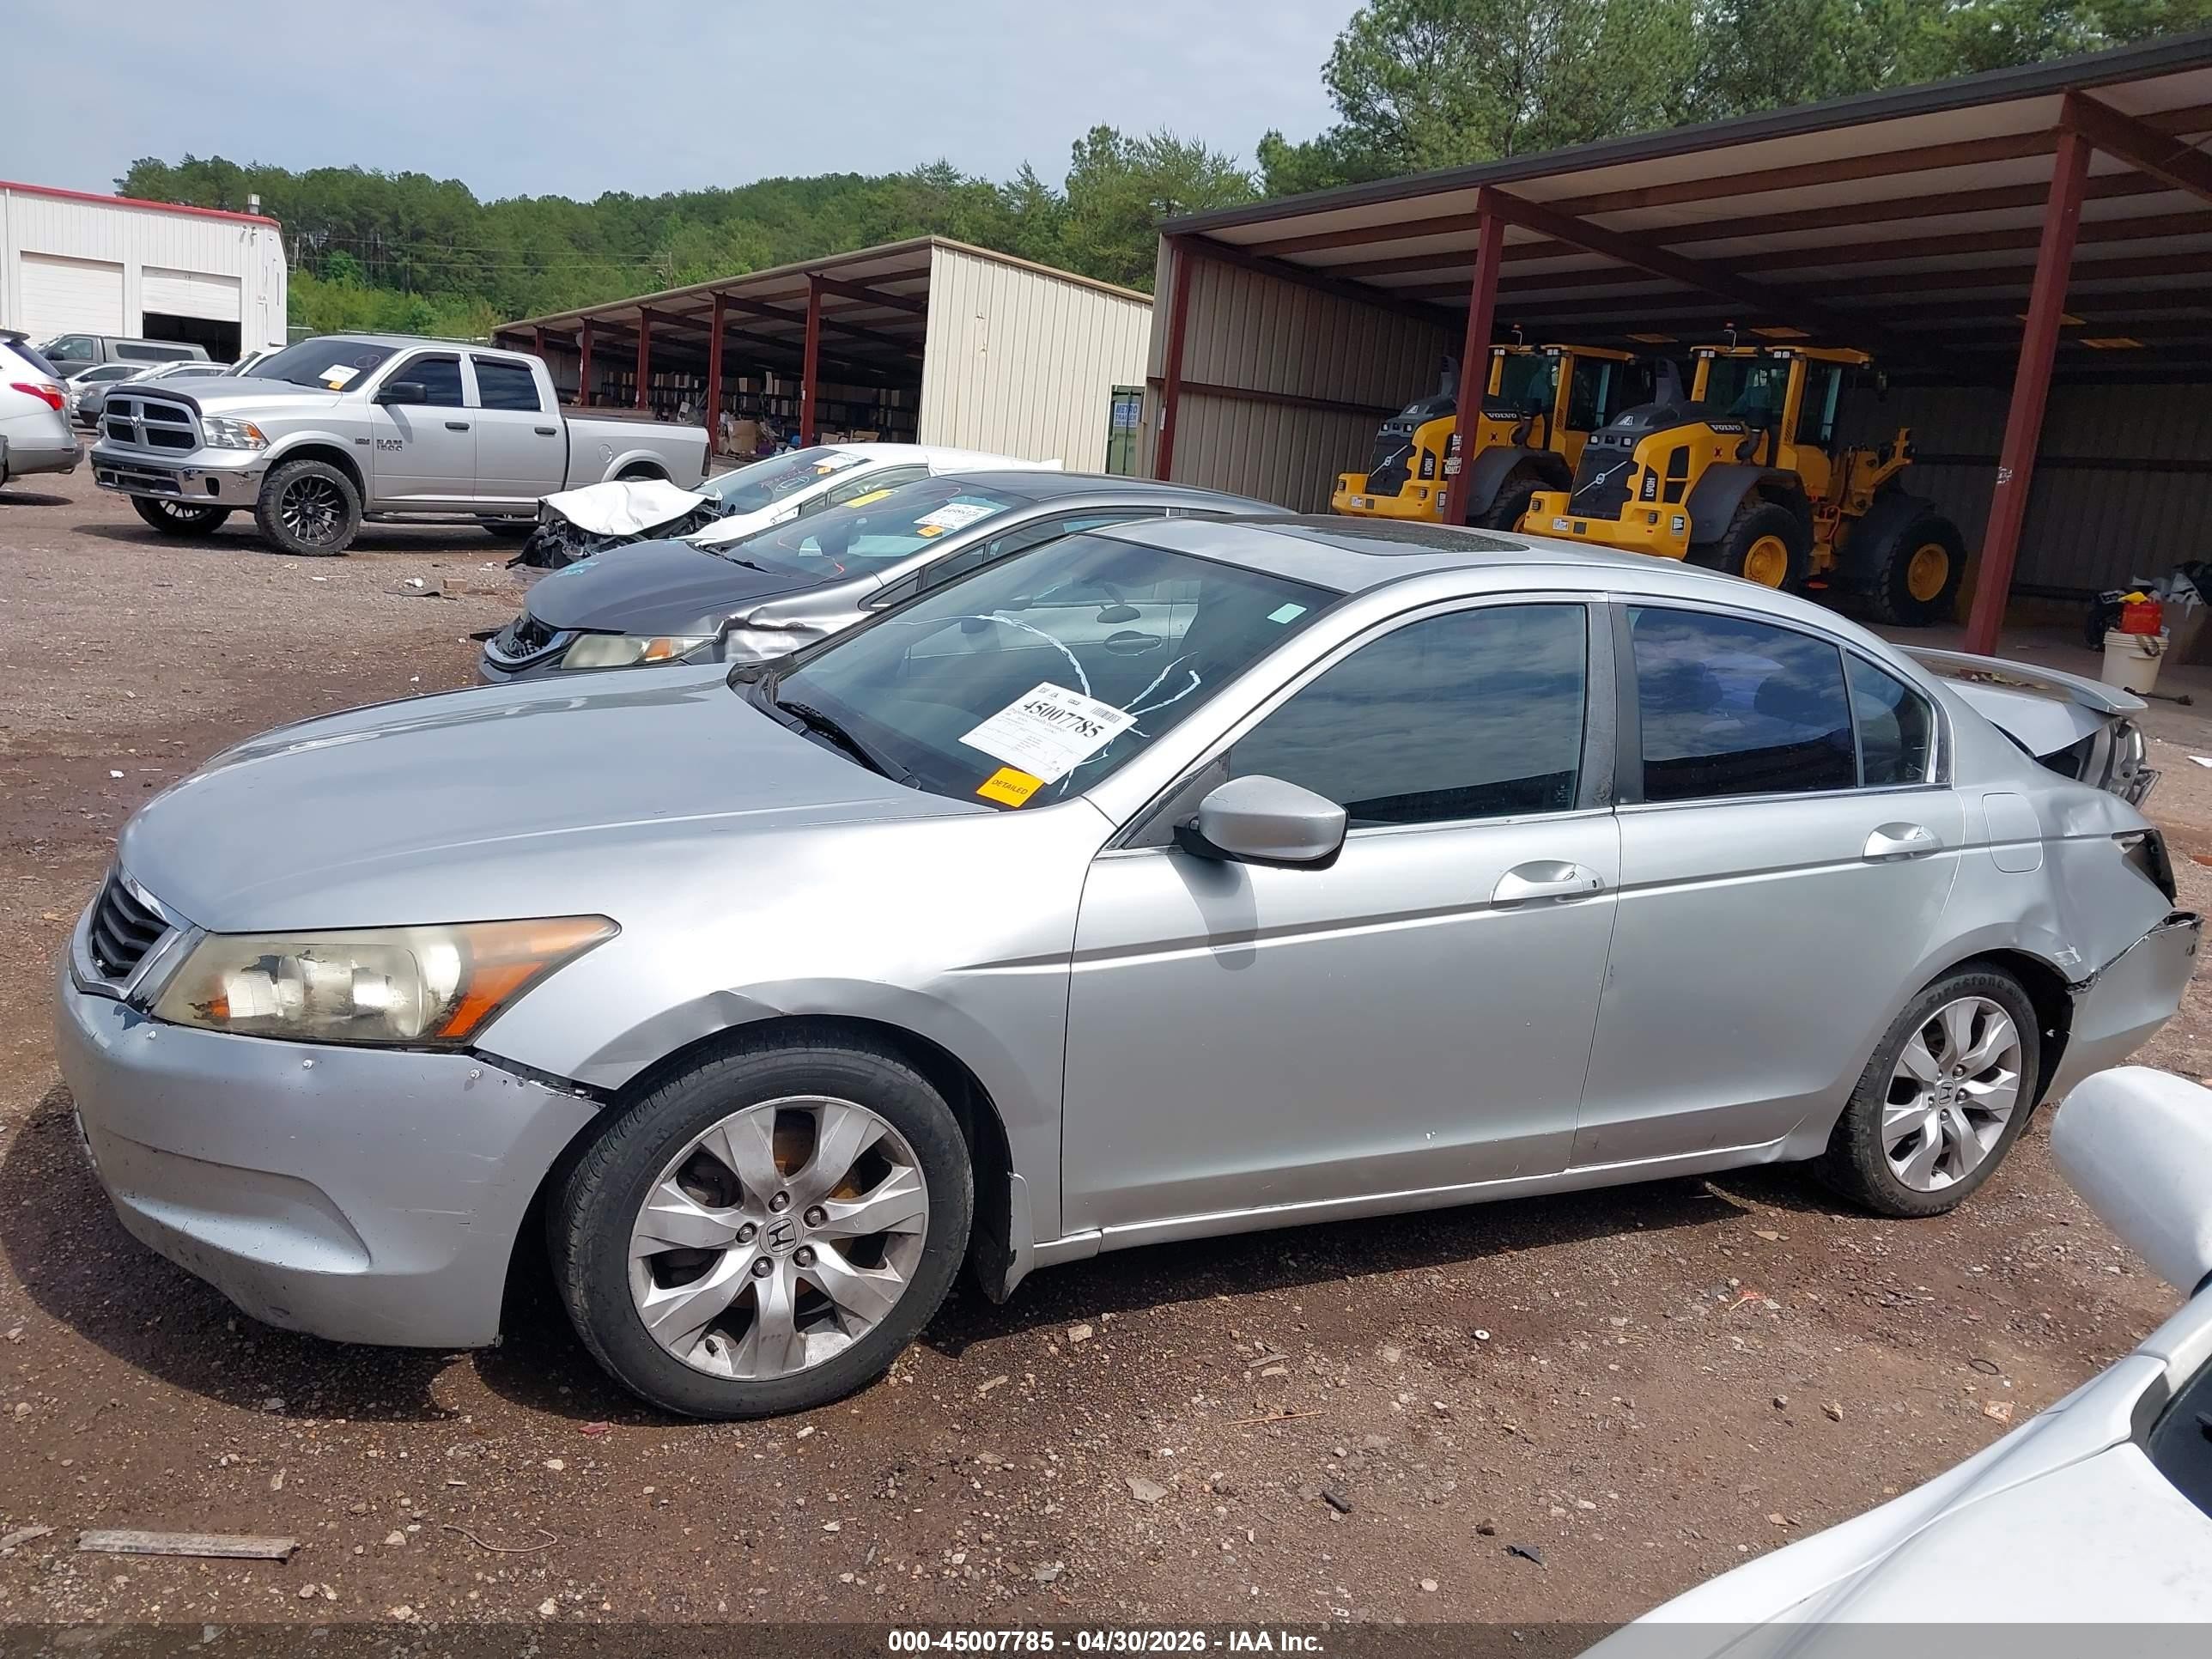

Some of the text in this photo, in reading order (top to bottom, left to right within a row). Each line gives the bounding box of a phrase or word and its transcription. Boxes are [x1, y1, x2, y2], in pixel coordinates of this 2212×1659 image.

[1424, 458, 1434, 476] L90H
[1644, 477, 1656, 498] L90H
[1023, 700, 1104, 738] 45007785
[991, 779, 1029, 795] DETAILED
